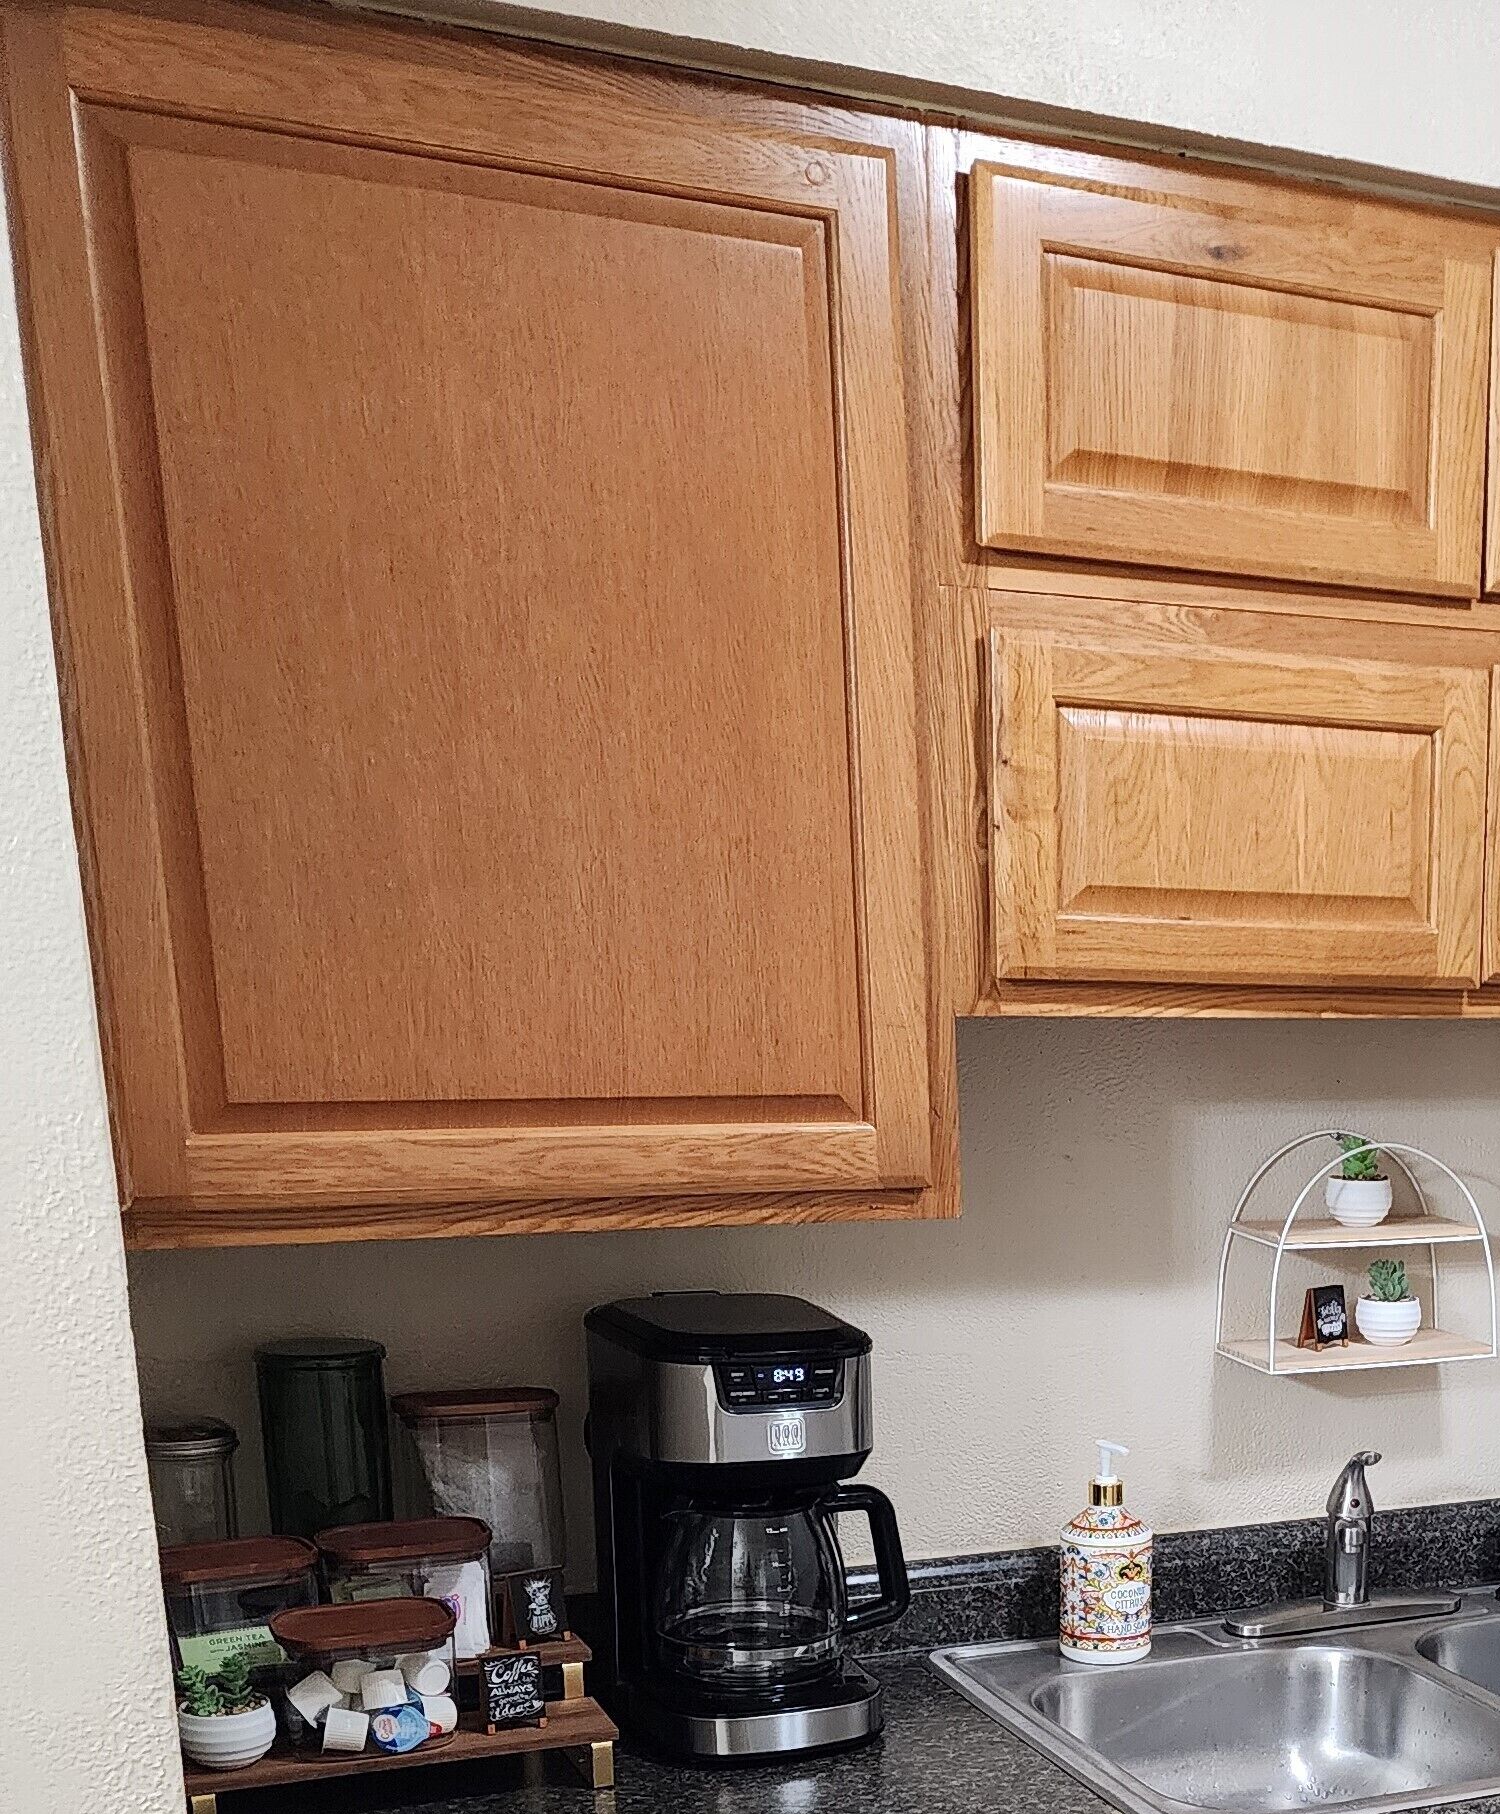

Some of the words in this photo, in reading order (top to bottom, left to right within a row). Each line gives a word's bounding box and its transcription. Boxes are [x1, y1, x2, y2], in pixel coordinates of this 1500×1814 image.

[1110, 1586, 1146, 1600] COCONUT
[1114, 1597, 1144, 1610] CITRUS
[1107, 1623, 1132, 1634] HAND
[208, 1635, 243, 1646] GREEN
[245, 1633, 265, 1641] TEA
[225, 1640, 268, 1652] JASMINE
[491, 1658, 535, 1684] Coffee
[489, 1684, 534, 1697] ALWAYS
